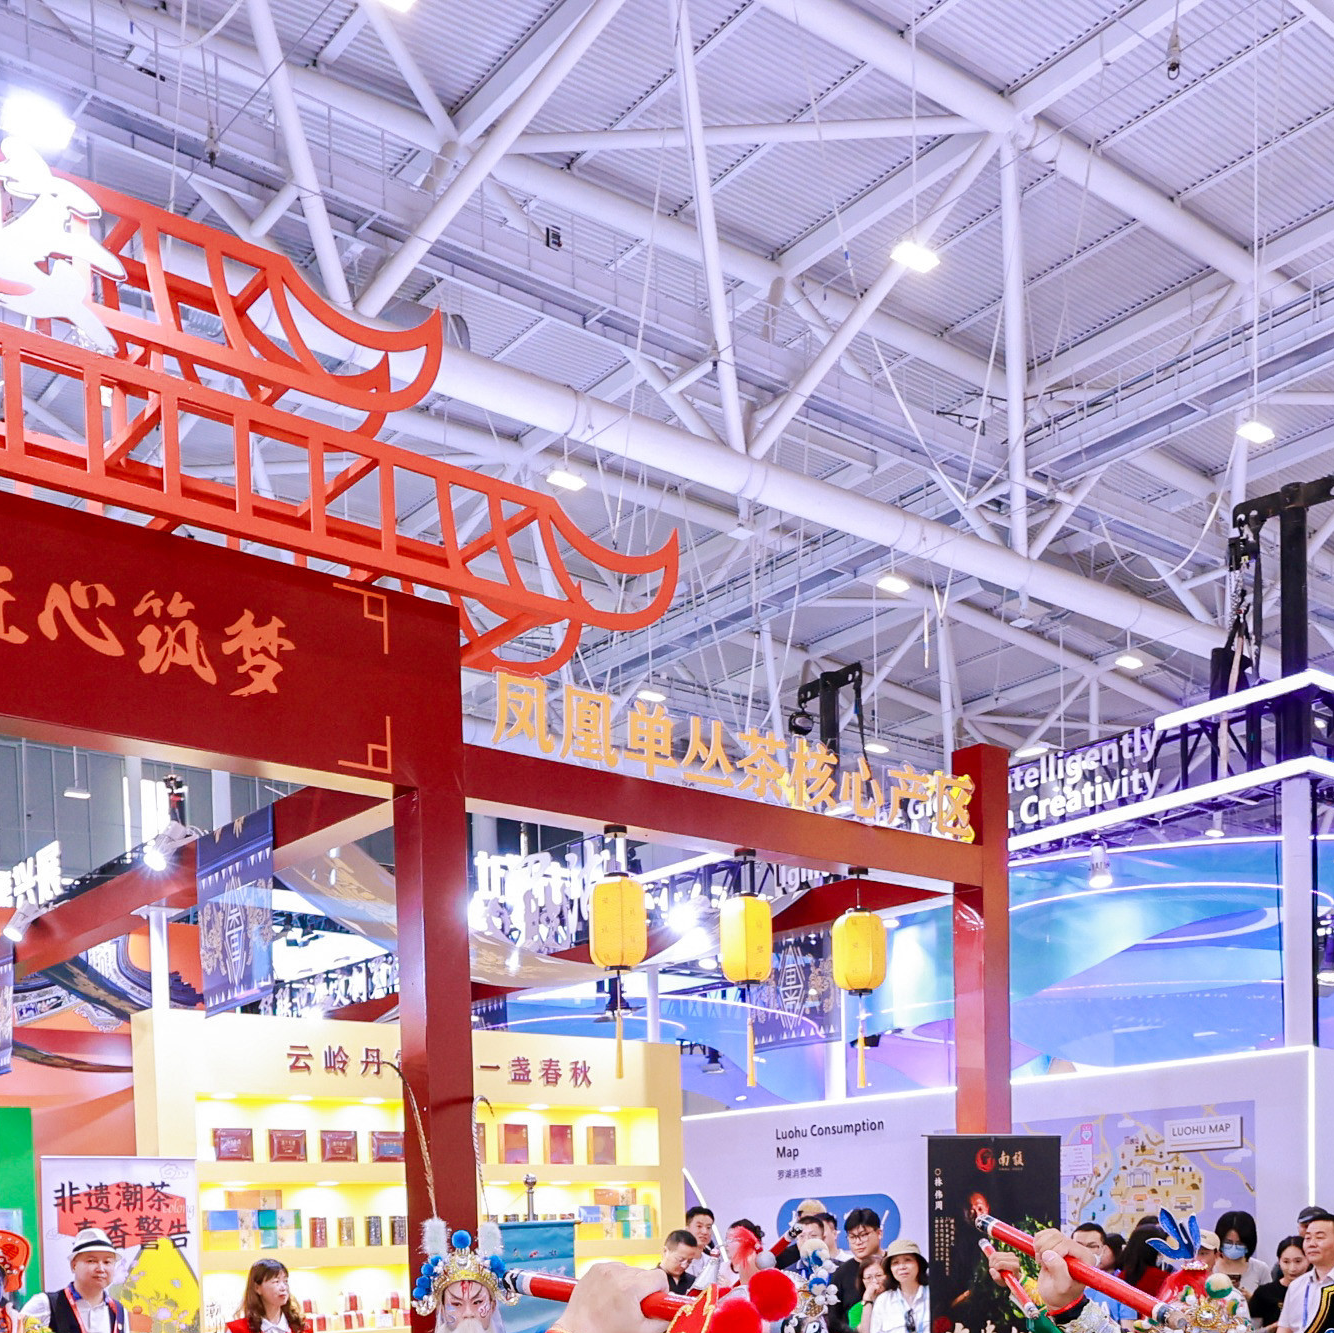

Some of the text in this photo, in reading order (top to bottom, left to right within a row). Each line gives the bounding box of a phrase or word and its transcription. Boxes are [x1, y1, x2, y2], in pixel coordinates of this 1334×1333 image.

[491, 670, 975, 842] 凤凰单丛茶核心产区
[1019, 767, 1161, 825] Creativity
[479, 1056, 593, 1088] 一盏春秋
[775, 1118, 884, 1141] Luohu Consumption
[1172, 1122, 1231, 1138] LUOHU MAP
[776, 1145, 800, 1160] Map
[53, 1181, 173, 1214] 非遗潮茶
